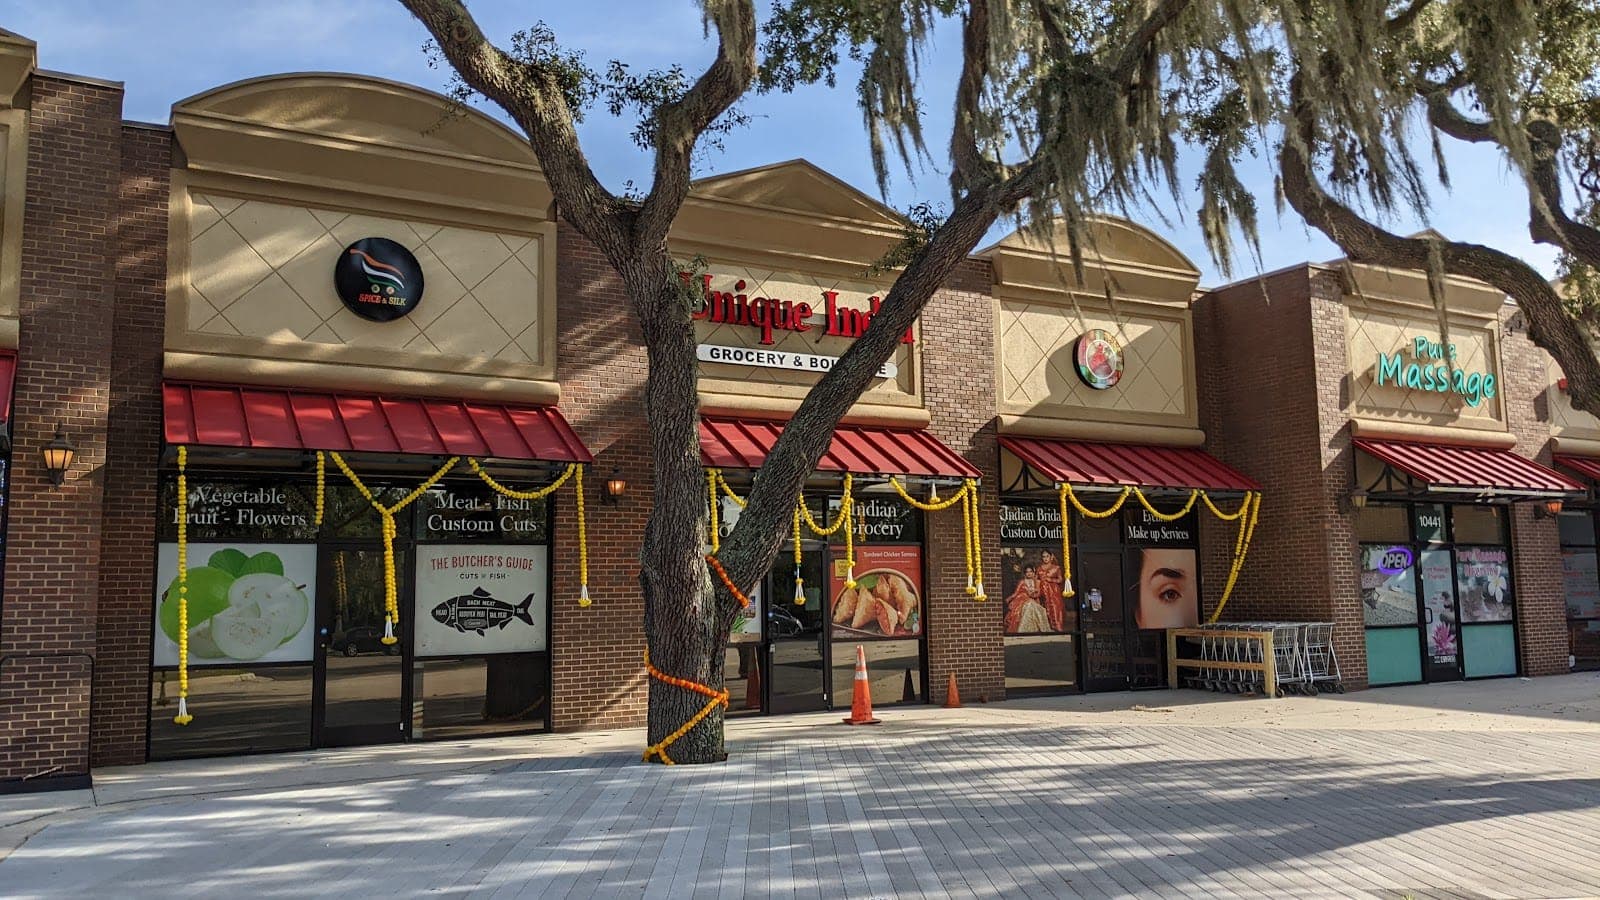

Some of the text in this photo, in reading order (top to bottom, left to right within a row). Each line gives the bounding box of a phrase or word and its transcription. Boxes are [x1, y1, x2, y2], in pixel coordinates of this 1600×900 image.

[359, 293, 381, 304] SPICE
[389, 296, 407, 306] SILK
[710, 347, 786, 366] GROCERY
[793, 355, 803, 367] &
[1414, 336, 1457, 360] Pure
[1378, 352, 1496, 408] Massage
[196, 486, 286, 507] Vegetable
[436, 492, 482, 510] Meat
[496, 494, 530, 510] Fish
[237, 508, 306, 526] Flowers
[850, 499, 898, 518] Indian
[1001, 505, 1063, 521] Indian Brida
[427, 514, 537, 532] Custom Cuts
[844, 518, 903, 539] Grocery
[1420, 516, 1441, 527] 10441
[1001, 525, 1064, 538] Custom Outfi
[1128, 525, 1190, 542] Make up Services
[431, 555, 534, 571] THE BUTCHER'S GUIDE
[1382, 553, 1408, 568] OPEN
